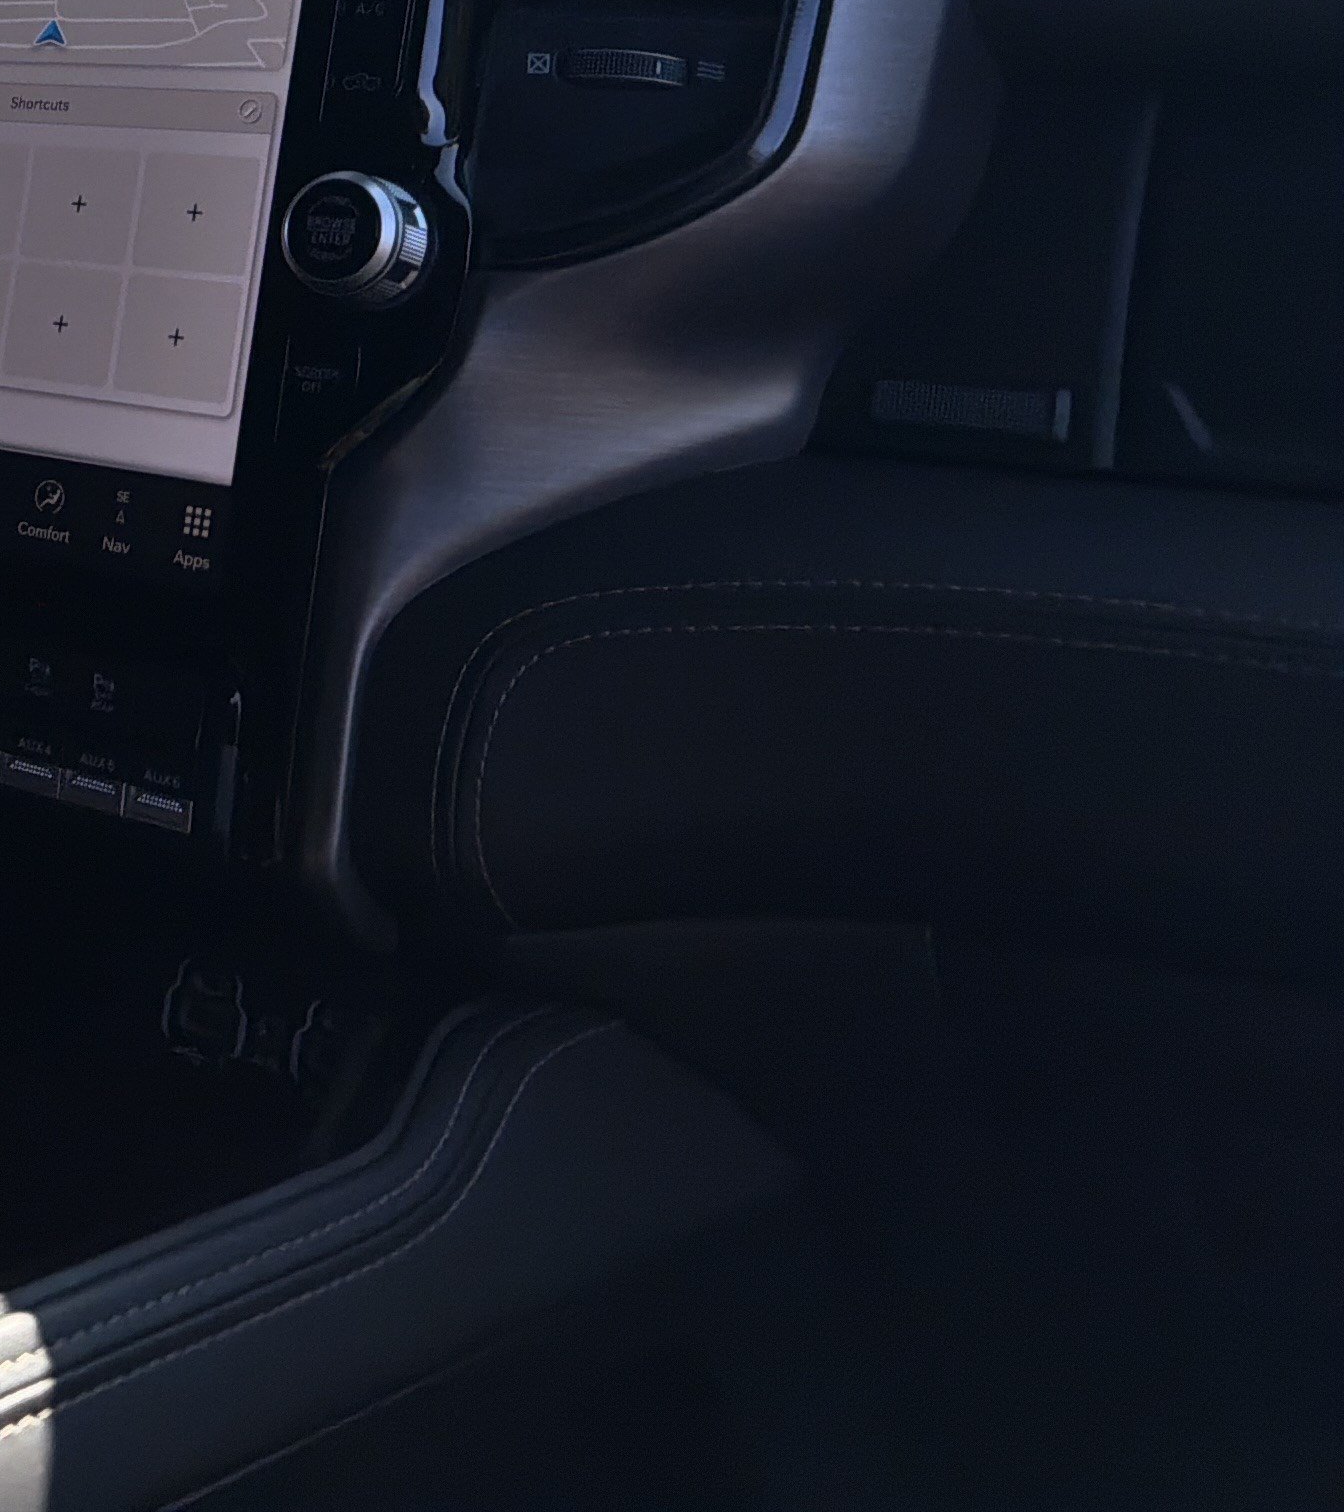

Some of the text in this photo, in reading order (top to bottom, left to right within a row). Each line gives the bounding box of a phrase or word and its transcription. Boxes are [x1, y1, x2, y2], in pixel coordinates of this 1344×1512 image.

[10, 95, 70, 112] Shortcuts
[116, 490, 130, 504] SE
[17, 520, 71, 544] Comfort
[101, 535, 131, 555] Nav
[173, 548, 211, 572] Apps
